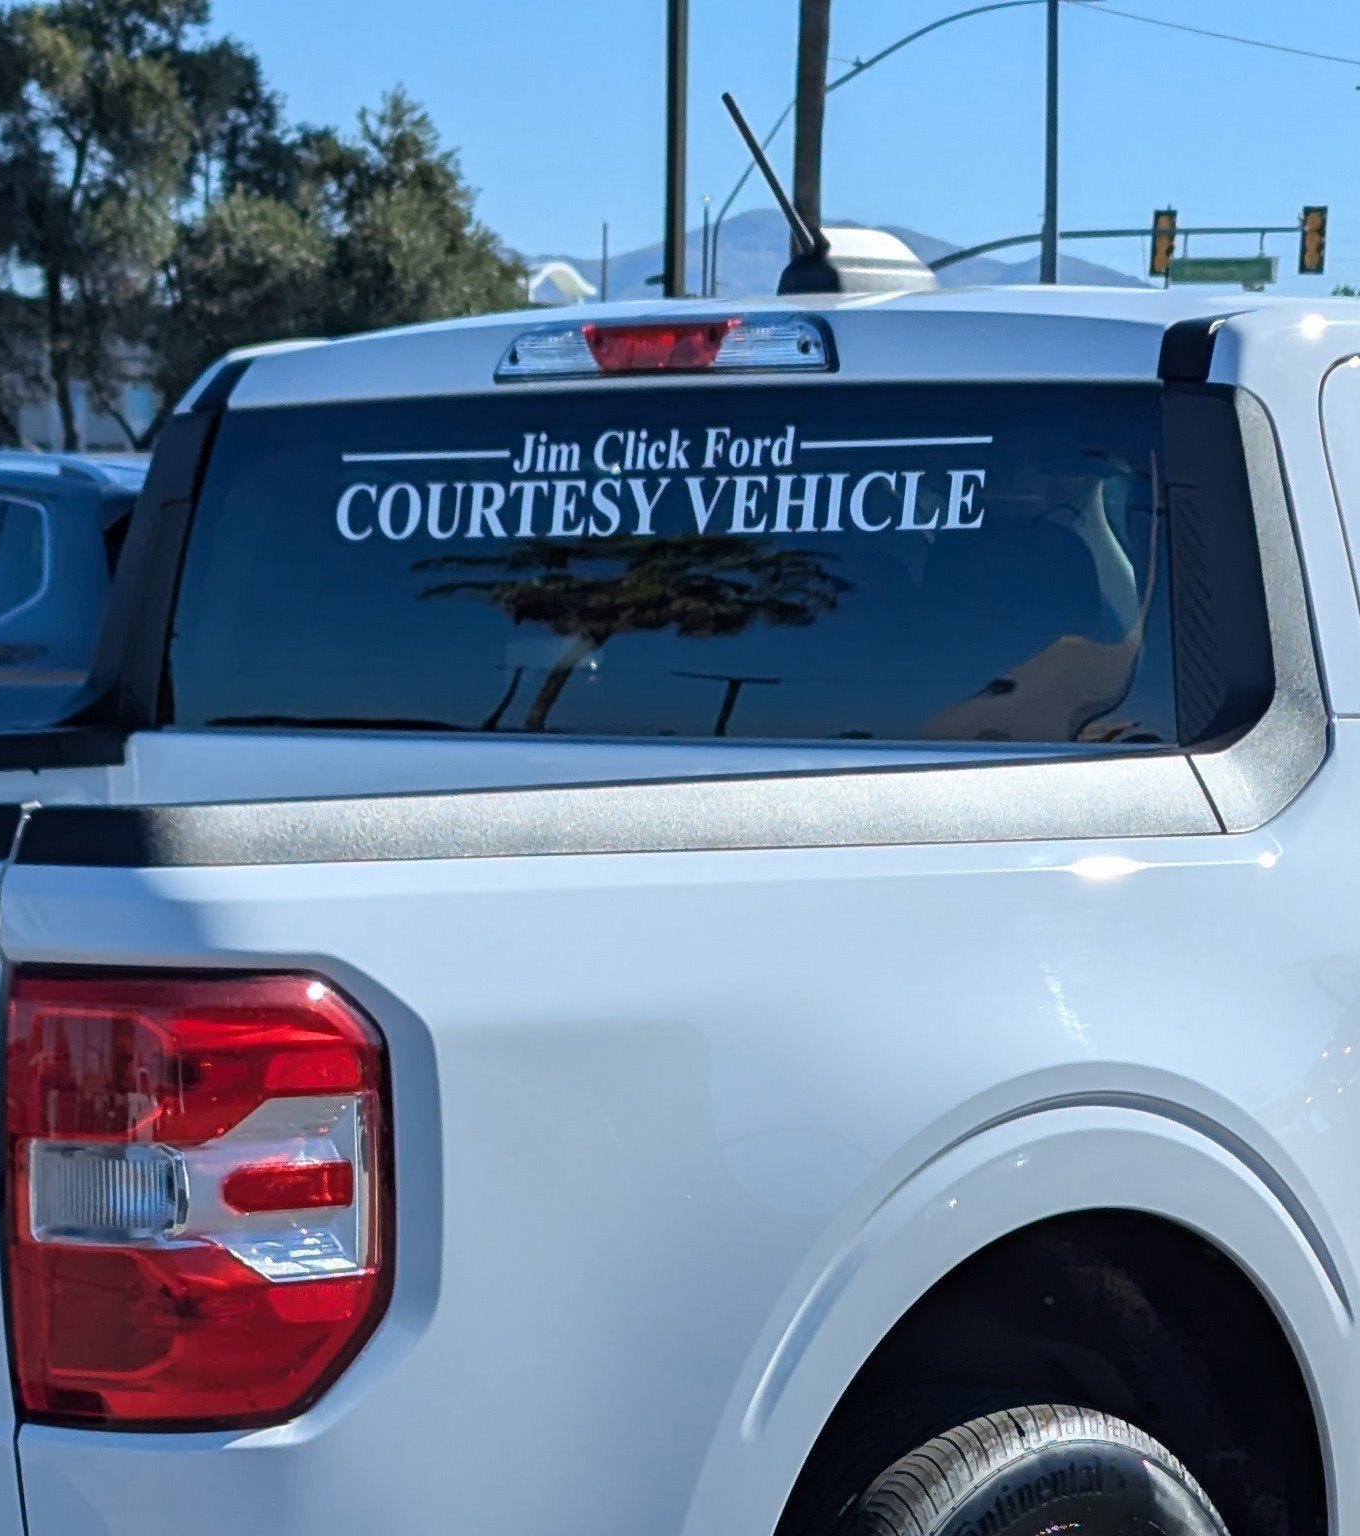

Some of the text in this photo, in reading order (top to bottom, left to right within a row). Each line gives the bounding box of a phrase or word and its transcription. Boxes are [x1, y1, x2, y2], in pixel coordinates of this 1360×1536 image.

[512, 425, 796, 475] Jim Click Ford
[336, 469, 986, 541] COURTESY VEHICLE
